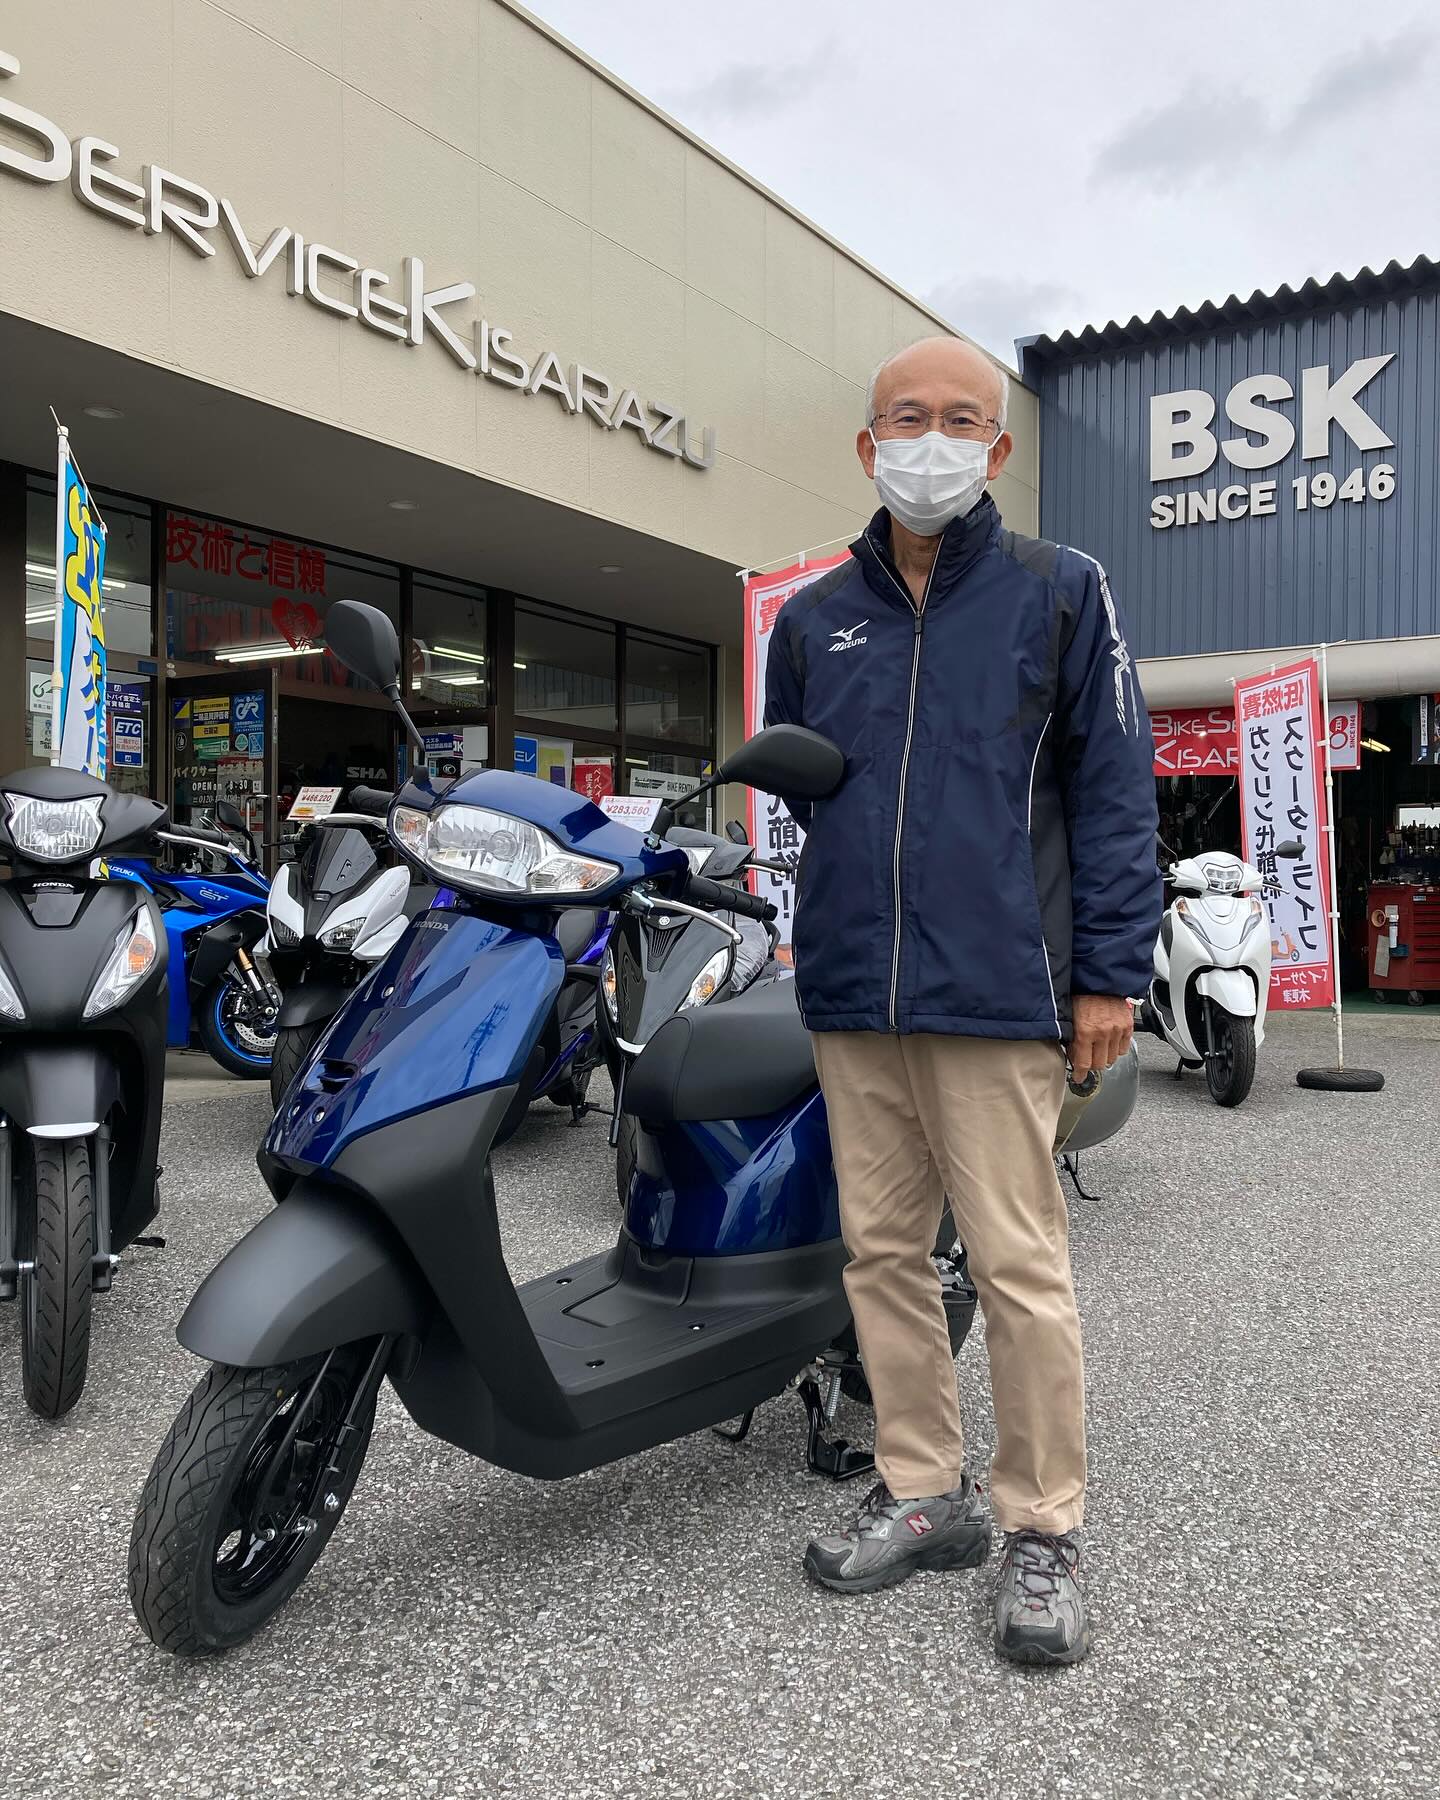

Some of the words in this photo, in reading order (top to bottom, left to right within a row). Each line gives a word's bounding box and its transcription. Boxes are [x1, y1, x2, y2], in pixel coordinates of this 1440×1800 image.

[404, 256, 716, 470] KISARAZU
[1150, 353, 1397, 482] BSK
[1149, 480, 1277, 529] SINCE
[1292, 463, 1396, 510] 1946
[166, 511, 327, 596] 技術と信頼
[116, 722, 141, 734] ETC
[1151, 714, 1206, 737] BIKE
[192, 781, 212, 791] OPEN
[32, 881, 75, 889] HONDA
[412, 921, 449, 931] HONDA
[908, 1514, 934, 1536] N
